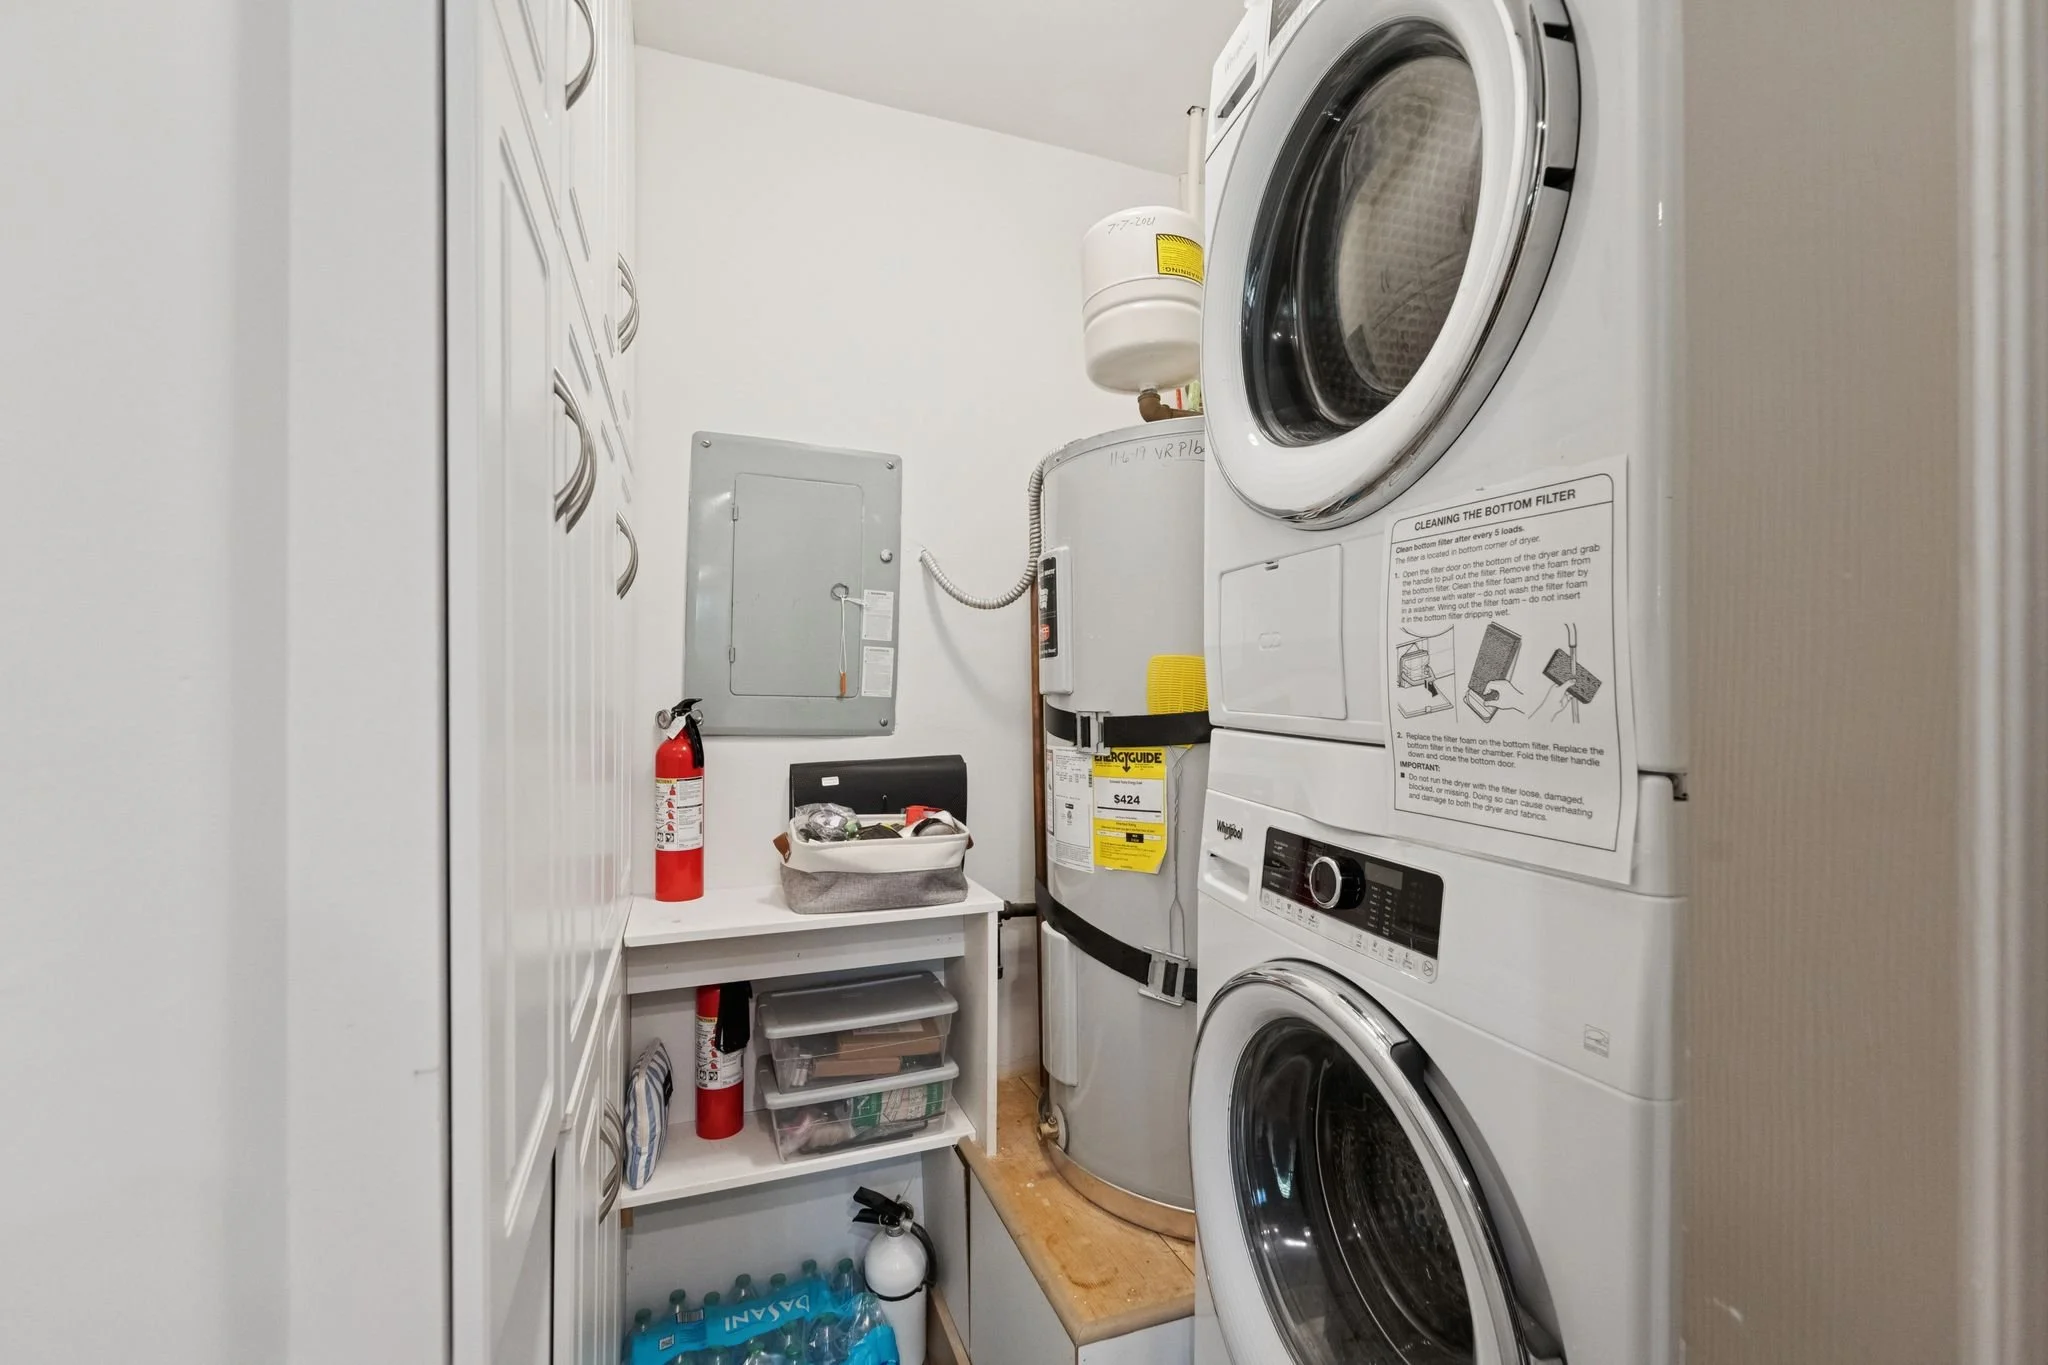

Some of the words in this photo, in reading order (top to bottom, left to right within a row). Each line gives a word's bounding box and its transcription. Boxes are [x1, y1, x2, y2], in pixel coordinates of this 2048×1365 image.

[1415, 513, 1460, 531] CLEANING
[1463, 508, 1482, 522] THE
[1485, 498, 1532, 516] BOTTOM
[1536, 489, 1575, 506] FILTER
[1414, 542, 1436, 550] bottom
[1473, 531, 1492, 540] every
[1501, 525, 1524, 535] loads.
[1427, 550, 1449, 559] located
[1459, 545, 1483, 554] bottom
[1484, 541, 1508, 550] corner
[1510, 538, 1517, 546] of
[1519, 536, 1540, 545] dryer.
[1403, 570, 1418, 578] Open
[1486, 557, 1512, 566] bottom
[1514, 554, 1521, 562] of
[1538, 550, 1559, 560] dryer
[1561, 546, 1577, 556] and
[1580, 544, 1600, 555] grab
[1413, 577, 1432, 585] handle
[1442, 574, 1453, 582] pull
[1500, 565, 1530, 575] Remove
[1548, 560, 1568, 568] foam
[1571, 558, 1591, 566] from
[1412, 586, 1434, 595] bottom
[1452, 582, 1471, 590] Clean
[1557, 570, 1575, 578] filter
[1578, 569, 1588, 578] by
[1508, 586, 1528, 594] wash
[1557, 592, 1580, 600] insert
[1464, 610, 1493, 619] dripping
[1495, 608, 1510, 616] wet.
[1406, 732, 1431, 741] Replace
[1503, 740, 1530, 749] bottom
[1532, 742, 1551, 751] filter.
[1553, 744, 1588, 754] Replace
[1590, 747, 1604, 755] the
[1095, 752, 1162, 763] ENERGYGUIDE
[1400, 761, 1440, 772] IMPORTANT:
[1470, 757, 1495, 766] bottom
[1482, 749, 1515, 758] chamber.
[1517, 751, 1534, 760] Fold
[1550, 754, 1568, 763] filter
[1571, 756, 1600, 766] handle
[1114, 794, 1140, 805] $424
[1409, 783, 1435, 793] blocked,
[1444, 789, 1471, 799] missing.
[1473, 791, 1492, 803] Doing
[1520, 800, 1543, 809] cause
[1545, 804, 1593, 819] overheating
[1454, 780, 1471, 788] dryer
[1502, 786, 1517, 794] filter
[1520, 788, 1541, 799] loose,
[1544, 792, 1585, 805] damaged,
[1422, 794, 1446, 805] damage
[1485, 804, 1503, 814] dryer
[1521, 810, 1547, 821] fabrics.
[1216, 818, 1243, 840] Whirlpool
[725, 1295, 810, 1332] DASANI
